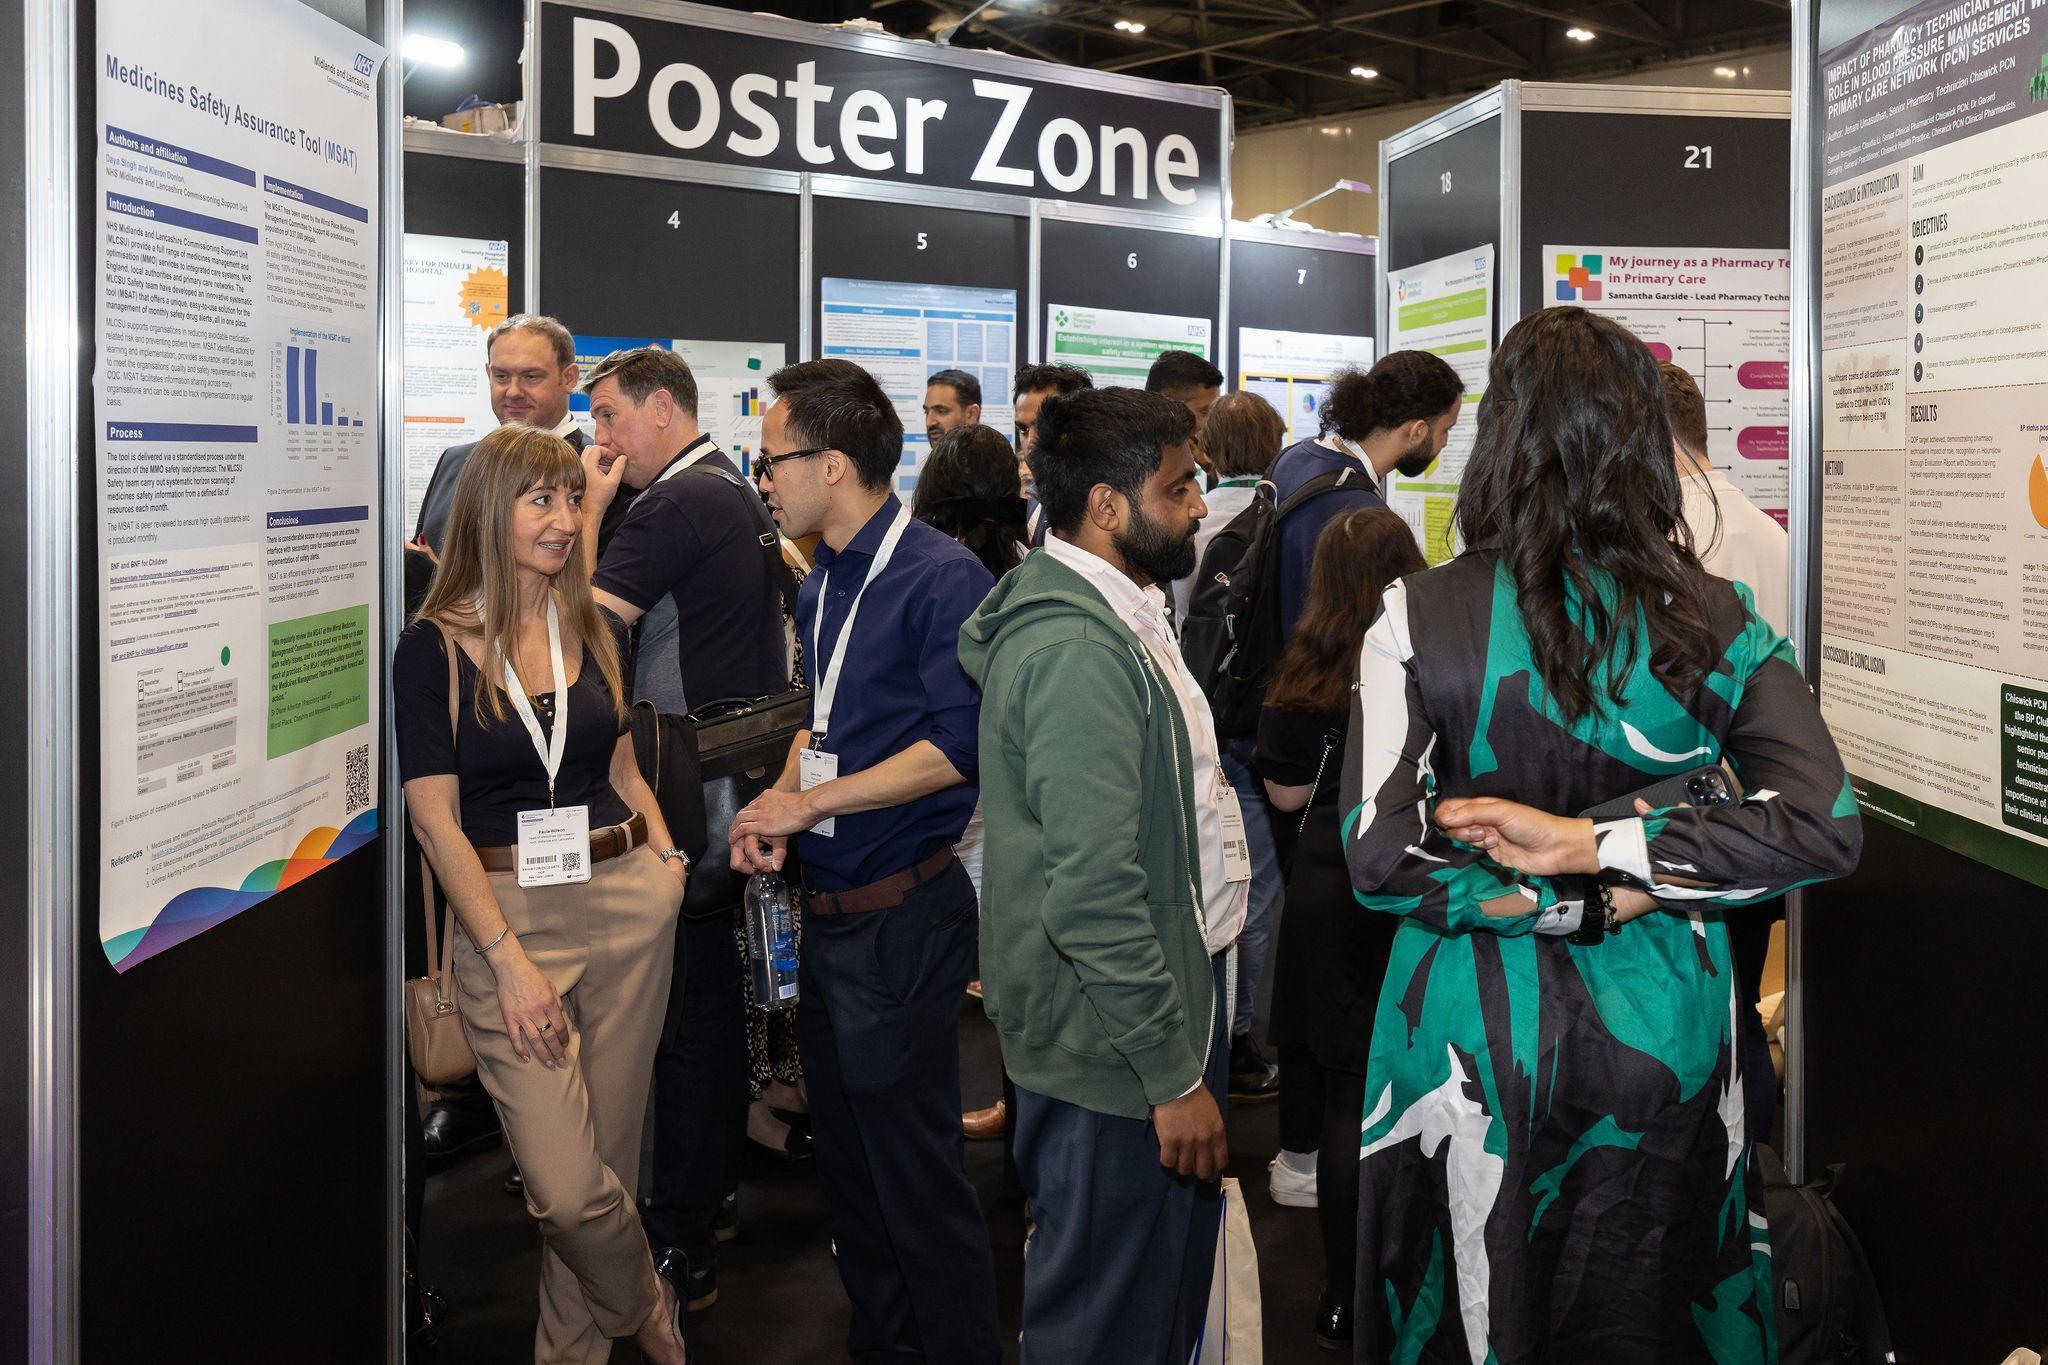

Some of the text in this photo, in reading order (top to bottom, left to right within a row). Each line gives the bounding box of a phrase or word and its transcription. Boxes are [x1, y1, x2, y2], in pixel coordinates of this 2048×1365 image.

[1828, 57, 1858, 84] IMPACT
[1860, 51, 1872, 70] OF
[1873, 24, 1924, 62] PHARMACY
[1829, 0, 2025, 103] ROLE IN BLOOD PRESSURE MANAGEMENT
[314, 56, 336, 75] Midlands
[337, 65, 345, 79] and
[346, 71, 370, 91] Lancashire
[355, 54, 375, 77] NHS
[1829, 16, 2031, 119] PRIMARY CARE NETWORK (PCN) SERVICES
[1889, 103, 1906, 117] Senior
[1906, 91, 1935, 109] Pharmacy
[1935, 78, 1969, 97] Technician
[1970, 64, 1999, 84] Chiswick
[1999, 55, 2017, 72] PCN
[106, 54, 357, 174] Medicines Safety Assurance Tool (MSAT)
[573, 16, 1201, 205] Poster Zone
[109, 130, 188, 166] Authors and affiliation
[1684, 145, 1713, 169] 21
[121, 157, 138, 171] Singh
[138, 163, 149, 174] and
[1912, 163, 1924, 183] AIM
[106, 166, 118, 179] NHS
[119, 168, 144, 185] Midlands
[145, 176, 156, 188] and
[156, 178, 183, 197] Lancashire
[183, 189, 220, 208] Commissioning
[220, 198, 240, 212] Support
[265, 180, 304, 200] Implementation
[1440, 171, 1452, 194] 18
[1824, 187, 1857, 212] BACKGROUND
[1861, 172, 1899, 200] INTRODUCTION
[109, 197, 155, 218] Introduction
[667, 210, 681, 229] 4
[1911, 212, 1948, 238] OBJECTIVES
[916, 232, 928, 250] 5
[1127, 252, 1138, 269] 6
[1609, 256, 1628, 269] My
[1631, 256, 1680, 270] journey
[1683, 259, 1697, 267] as
[1700, 259, 1708, 267] a
[1712, 257, 1775, 270] Pharmacy
[1297, 269, 1307, 285] 7
[1609, 273, 1707, 286] in Primary Care
[1608, 291, 1653, 300] Samantha
[1655, 292, 1689, 301] Garside
[1695, 293, 1716, 301] Lead
[1718, 293, 1761, 302] Pharmacy
[1188, 325, 1206, 337] NHS
[1910, 404, 1938, 422] RESULTS
[110, 427, 143, 438] Process
[107, 452, 118, 461] The
[119, 452, 130, 461] tool
[137, 452, 163, 461] delivered
[163, 452, 172, 461] via
[177, 452, 207, 461] standardised
[207, 453, 225, 463] process
[225, 452, 238, 461] under
[107, 465, 132, 474] direction
[132, 465, 139, 474] of
[139, 465, 149, 474] the
[150, 464, 164, 474] MMO
[165, 464, 181, 475] safety
[181, 464, 192, 473] lead
[192, 464, 218, 475] pharmacist.
[218, 464, 227, 473] The
[1824, 460, 1844, 476] METHOD
[107, 478, 124, 490] Safety
[125, 479, 140, 488] team
[140, 479, 156, 489] carry
[156, 478, 166, 487] out
[166, 477, 194, 488] systematic
[194, 477, 210, 485] horizon
[107, 490, 135, 501] medicines
[136, 490, 154, 501] safety
[154, 489, 185, 499] information
[185, 488, 197, 498] from
[201, 488, 218, 497] defined
[107, 502, 169, 514] resources each month.
[269, 516, 299, 526] Conclusions
[1823, 644, 1850, 666] DISCUSSION
[1854, 653, 1886, 675] CONCLUSION
[2005, 692, 2048, 710] Chiswick PCN
[2014, 710, 2025, 721] the
[2025, 712, 2035, 723] BP
[2004, 724, 2039, 741] highlighted
[2017, 745, 2037, 757] senior
[2005, 786, 2047, 808] importance of
[2004, 803, 2019, 815] their
[2019, 808, 2042, 823] clinical
[110, 849, 143, 868] References
